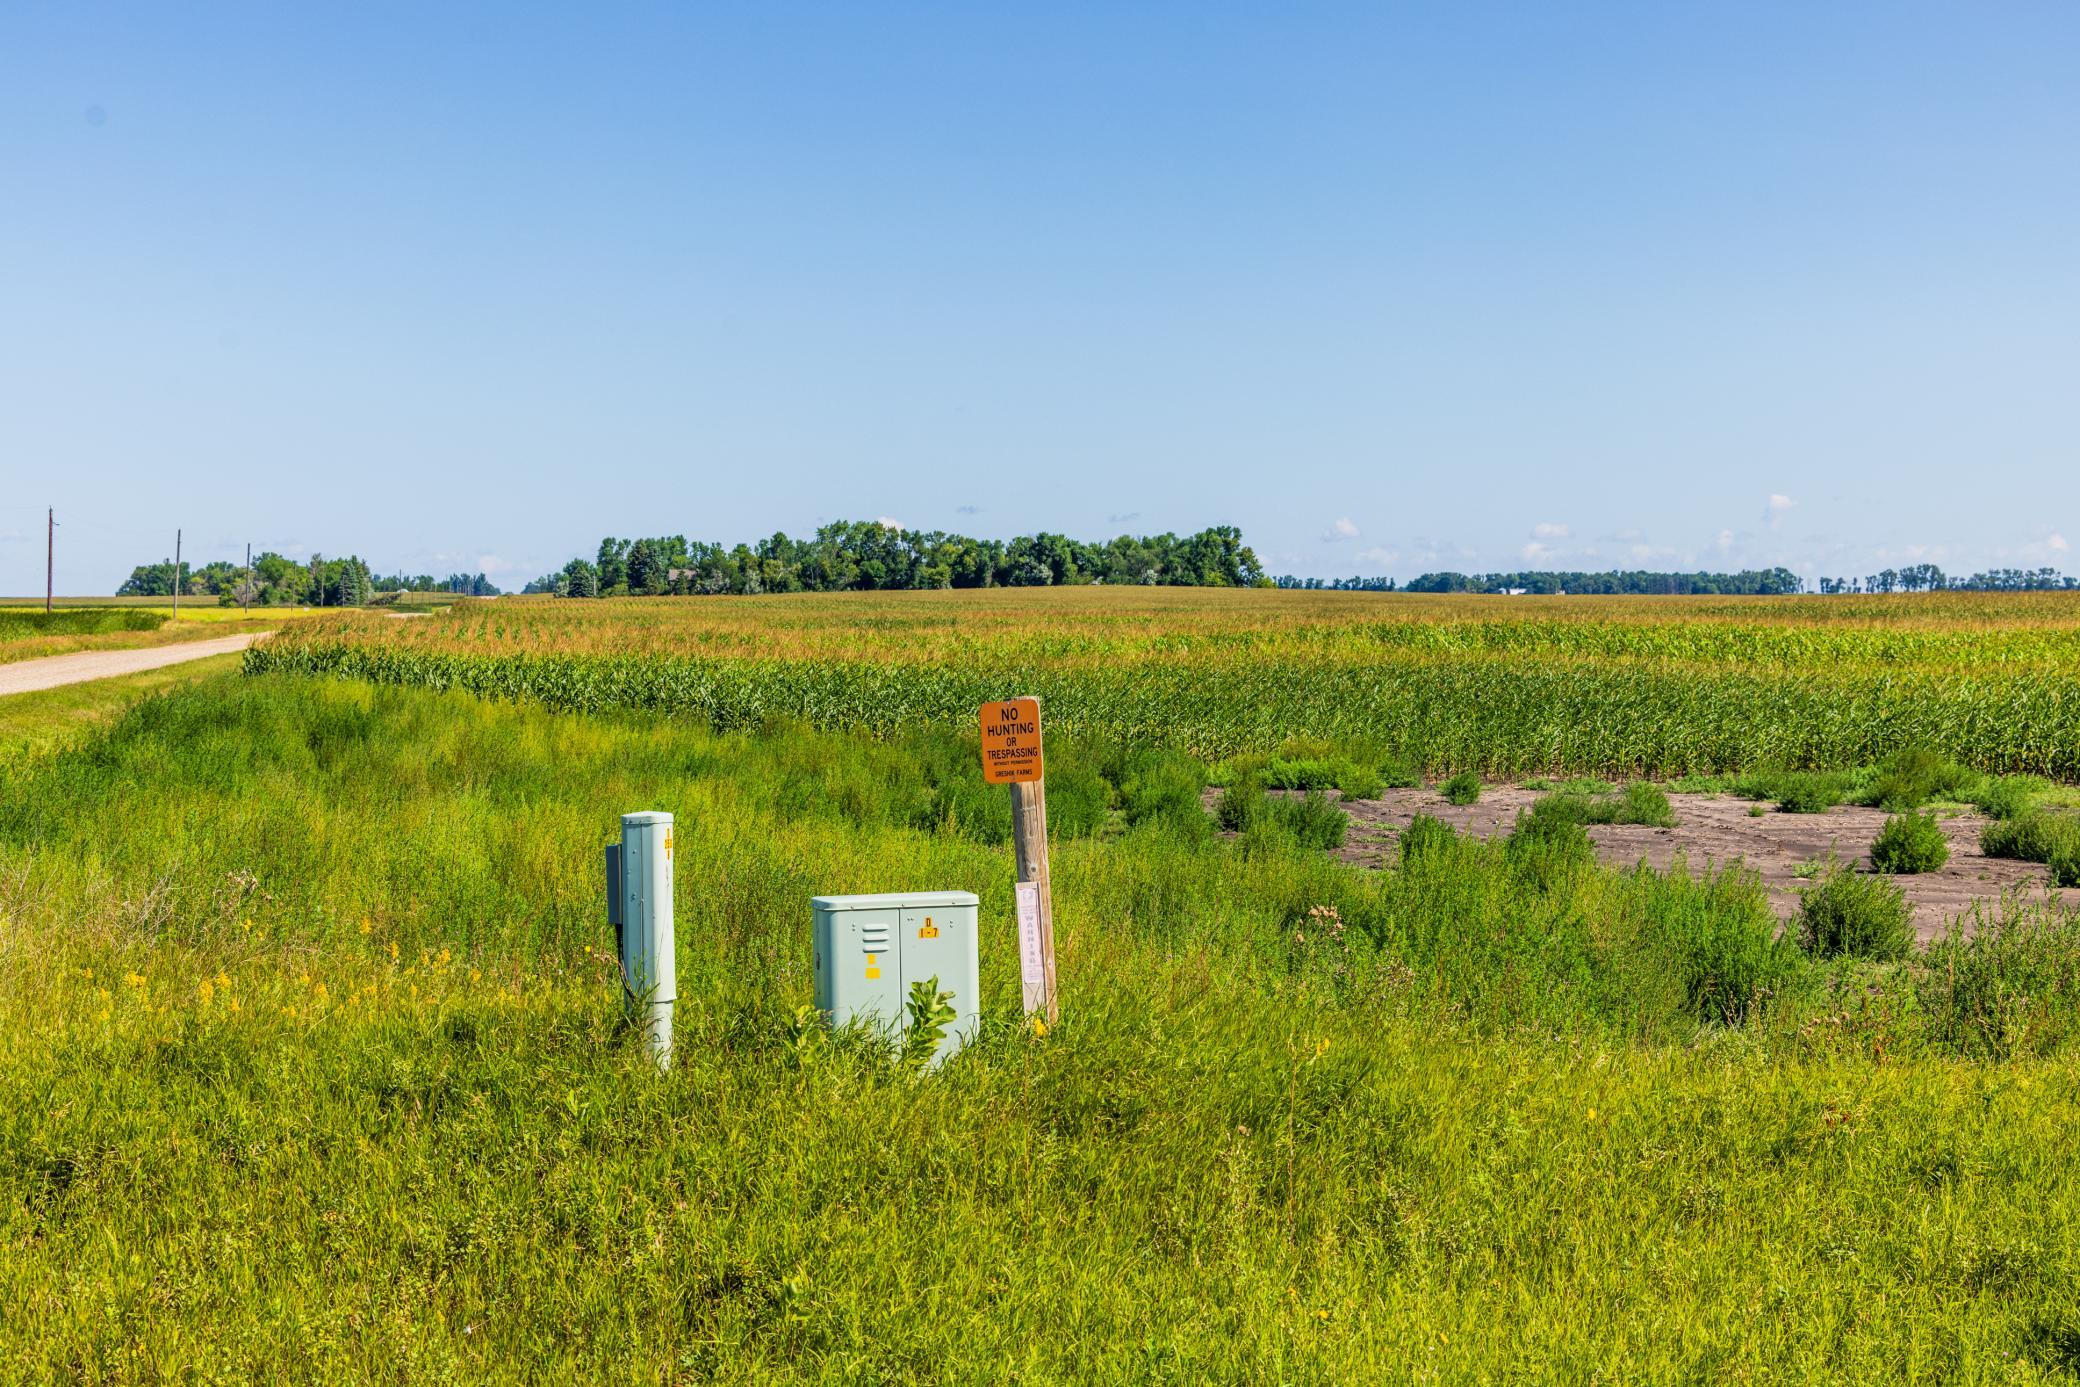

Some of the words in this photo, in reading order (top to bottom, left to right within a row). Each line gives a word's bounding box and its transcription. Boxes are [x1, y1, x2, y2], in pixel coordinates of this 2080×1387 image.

[1001, 708, 1018, 721] NO
[987, 722, 1034, 737] HUNTING
[1006, 737, 1017, 747] OR
[987, 747, 1038, 760] TRESPASSING
